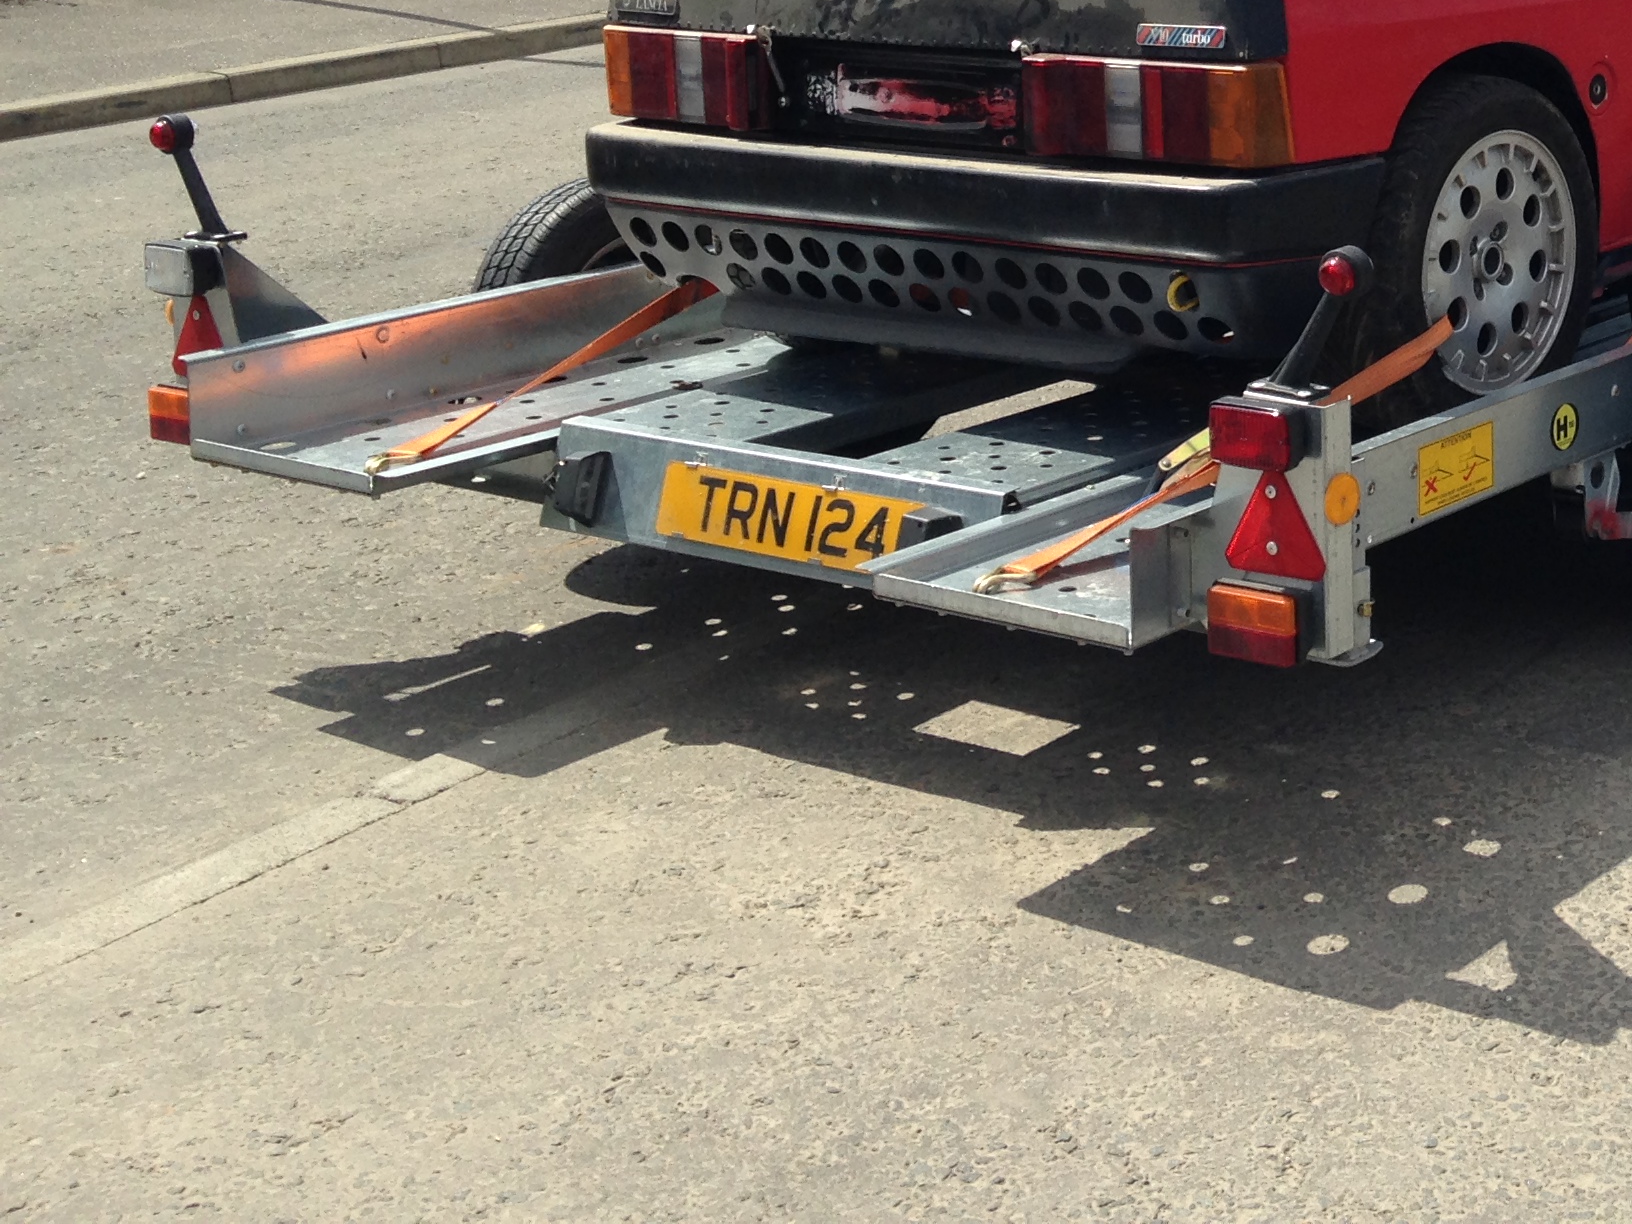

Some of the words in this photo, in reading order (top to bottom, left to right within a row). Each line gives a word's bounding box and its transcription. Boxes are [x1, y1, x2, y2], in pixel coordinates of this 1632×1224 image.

[1182, 29, 1211, 44] turbo
[699, 475, 796, 549] TRN
[803, 495, 890, 559] 124
